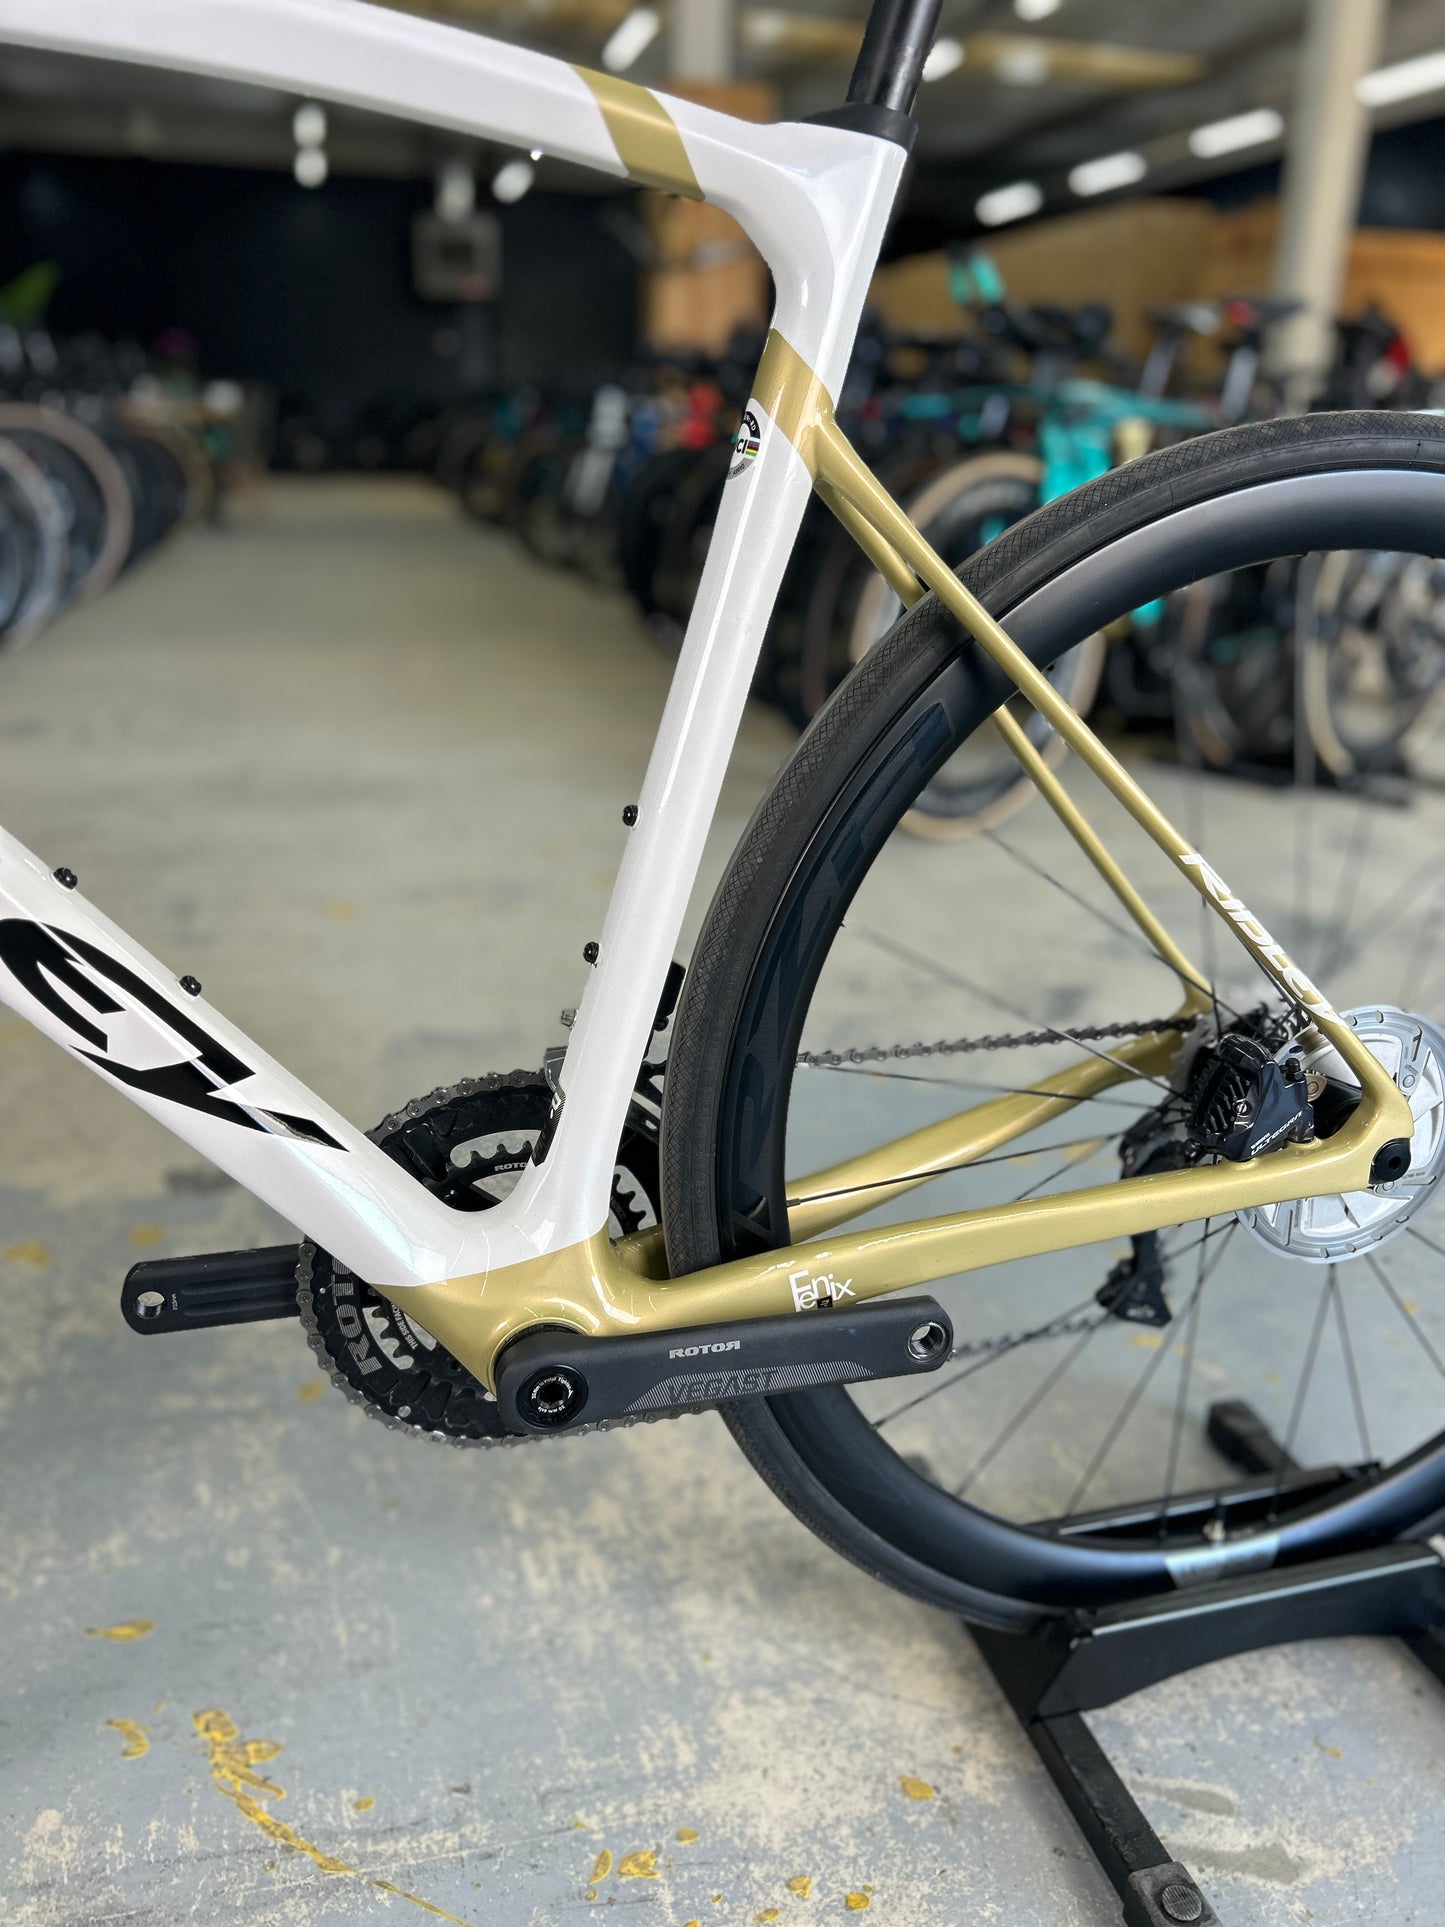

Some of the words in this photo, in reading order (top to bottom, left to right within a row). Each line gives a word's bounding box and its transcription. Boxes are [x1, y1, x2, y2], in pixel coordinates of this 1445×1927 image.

[736, 438, 748, 454] CI
[1178, 853, 1349, 1030] RIDLEY
[1250, 1110, 1303, 1156] ULTEGRA
[494, 1161, 527, 1173] ROTO
[789, 1269, 857, 1313] Fenix
[669, 1340, 741, 1359] ROTOR
